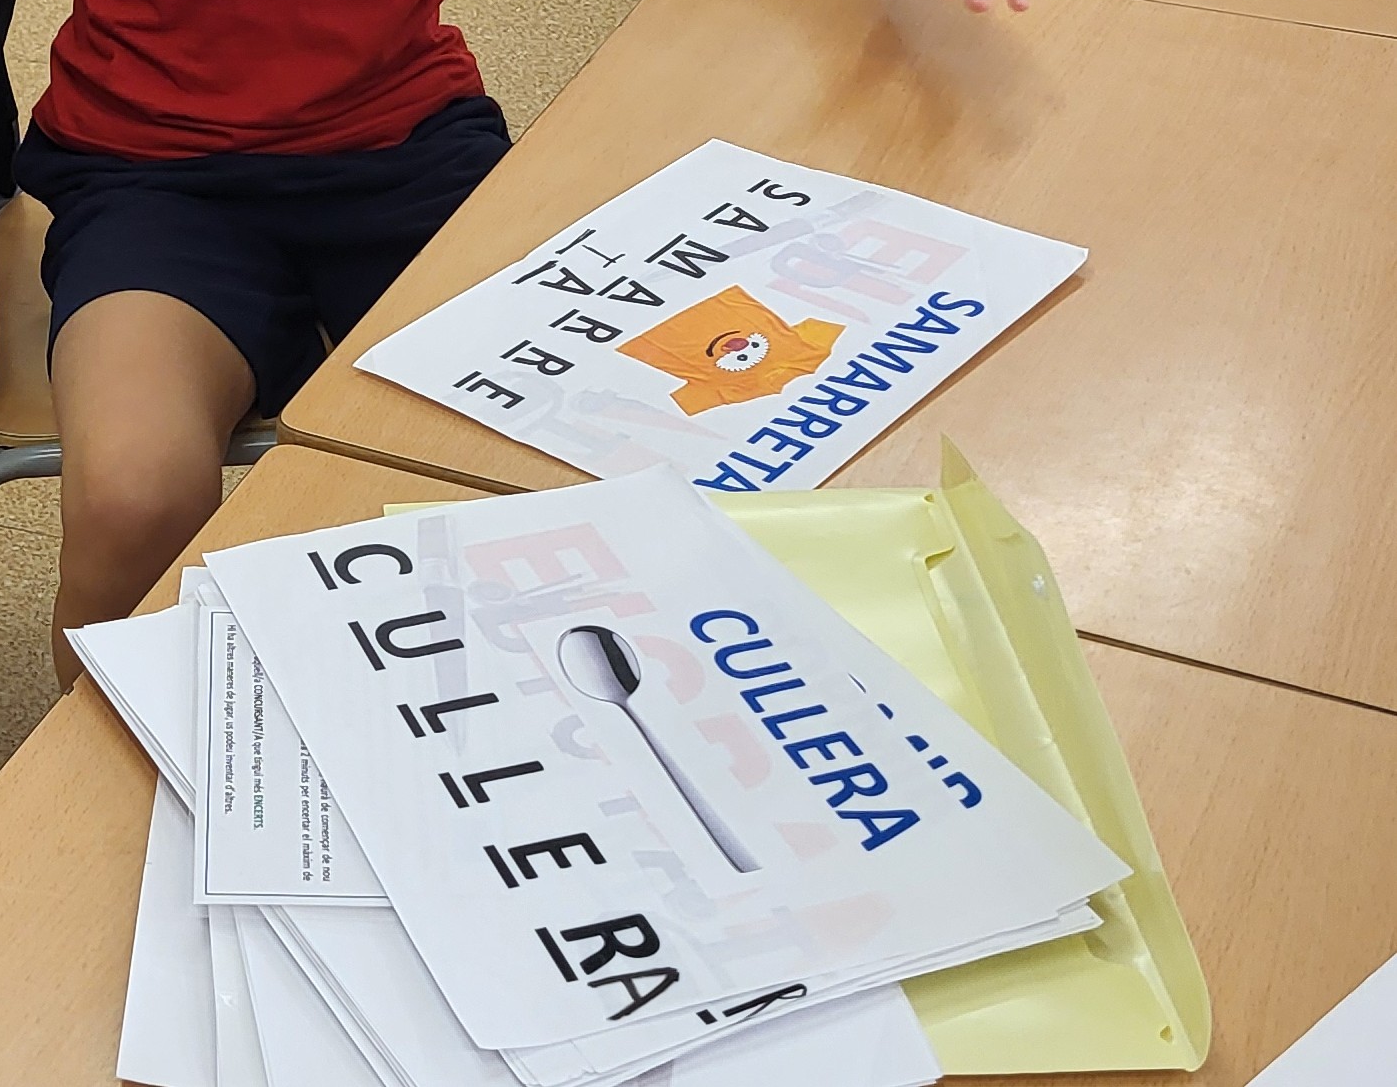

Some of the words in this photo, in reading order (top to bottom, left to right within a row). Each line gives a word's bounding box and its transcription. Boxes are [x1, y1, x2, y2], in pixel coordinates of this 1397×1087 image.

[692, 291, 985, 492] SAMARRETA
[689, 608, 921, 852] CULLERA
[252, 741, 262, 755] que
[301, 800, 311, 831] encertar
[319, 814, 331, 852] començar
[323, 867, 332, 881] nou
